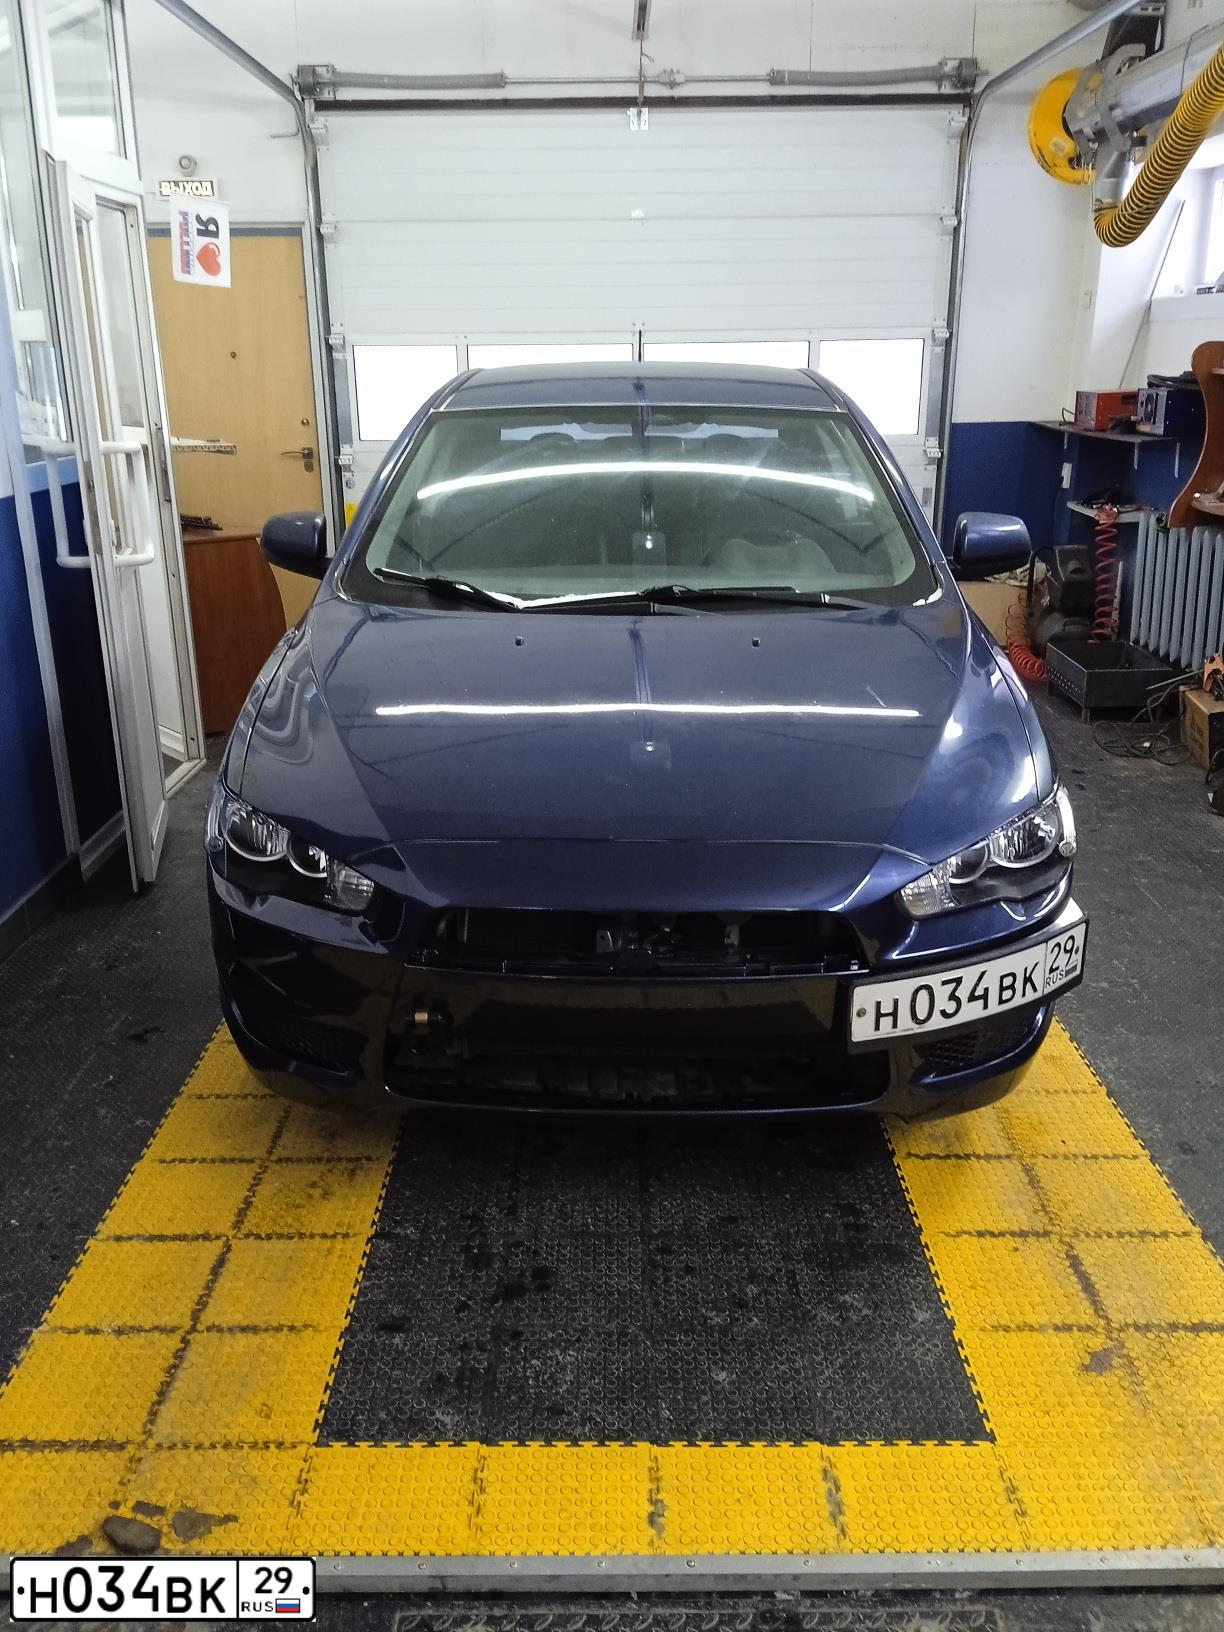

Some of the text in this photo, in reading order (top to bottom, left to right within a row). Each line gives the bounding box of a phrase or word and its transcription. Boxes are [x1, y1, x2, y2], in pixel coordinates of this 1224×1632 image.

[160, 181, 213, 196] ВЫХОД
[195, 213, 219, 239] Я
[1049, 935, 1076, 975] 29
[1045, 969, 1065, 987] RUS
